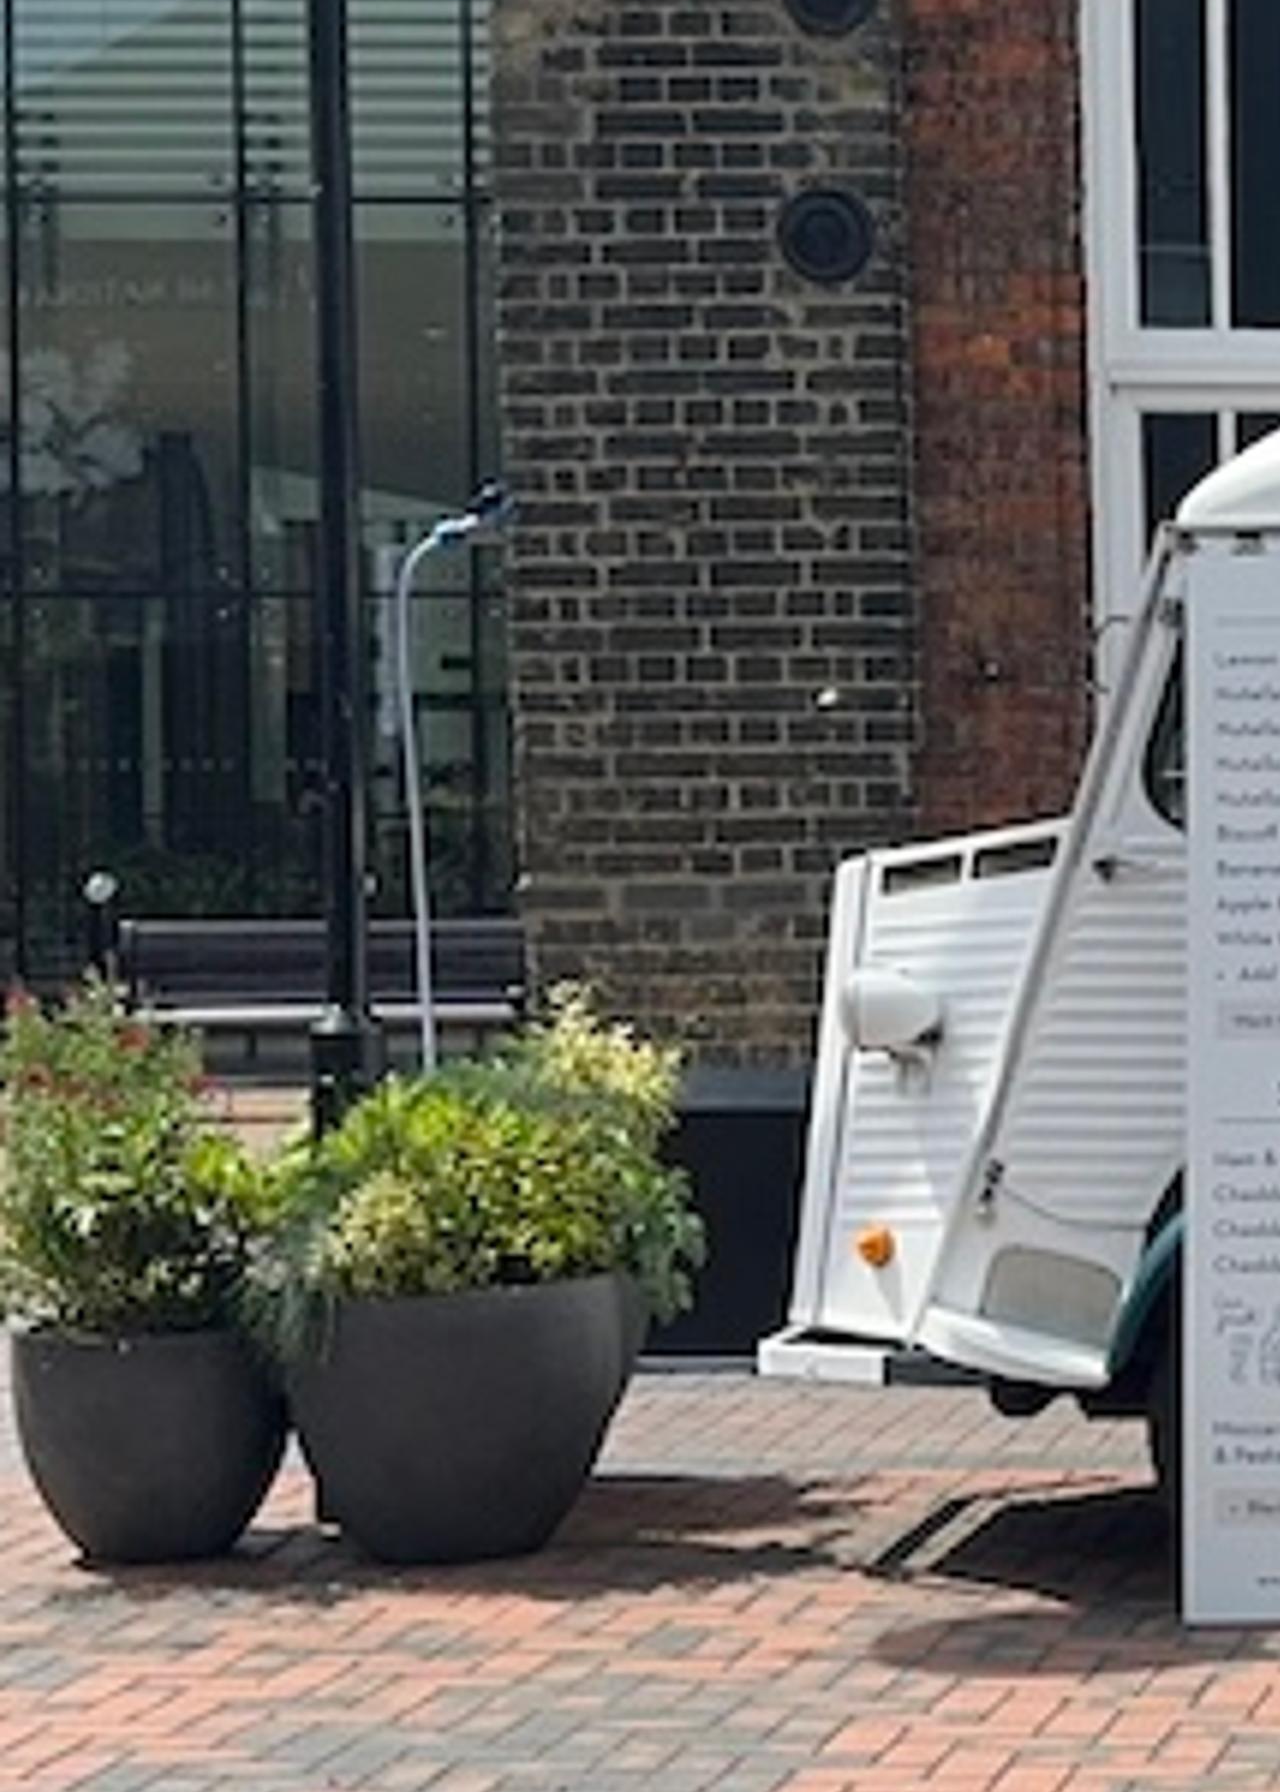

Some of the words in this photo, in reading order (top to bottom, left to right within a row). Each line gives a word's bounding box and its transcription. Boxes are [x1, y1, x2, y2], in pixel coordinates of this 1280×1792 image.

[1216, 897, 1273, 916] Apple
[1215, 930, 1273, 947] White
[1237, 964, 1278, 982] Add
[1263, 1148, 1278, 1167] &
[1213, 1445, 1227, 1465] &
